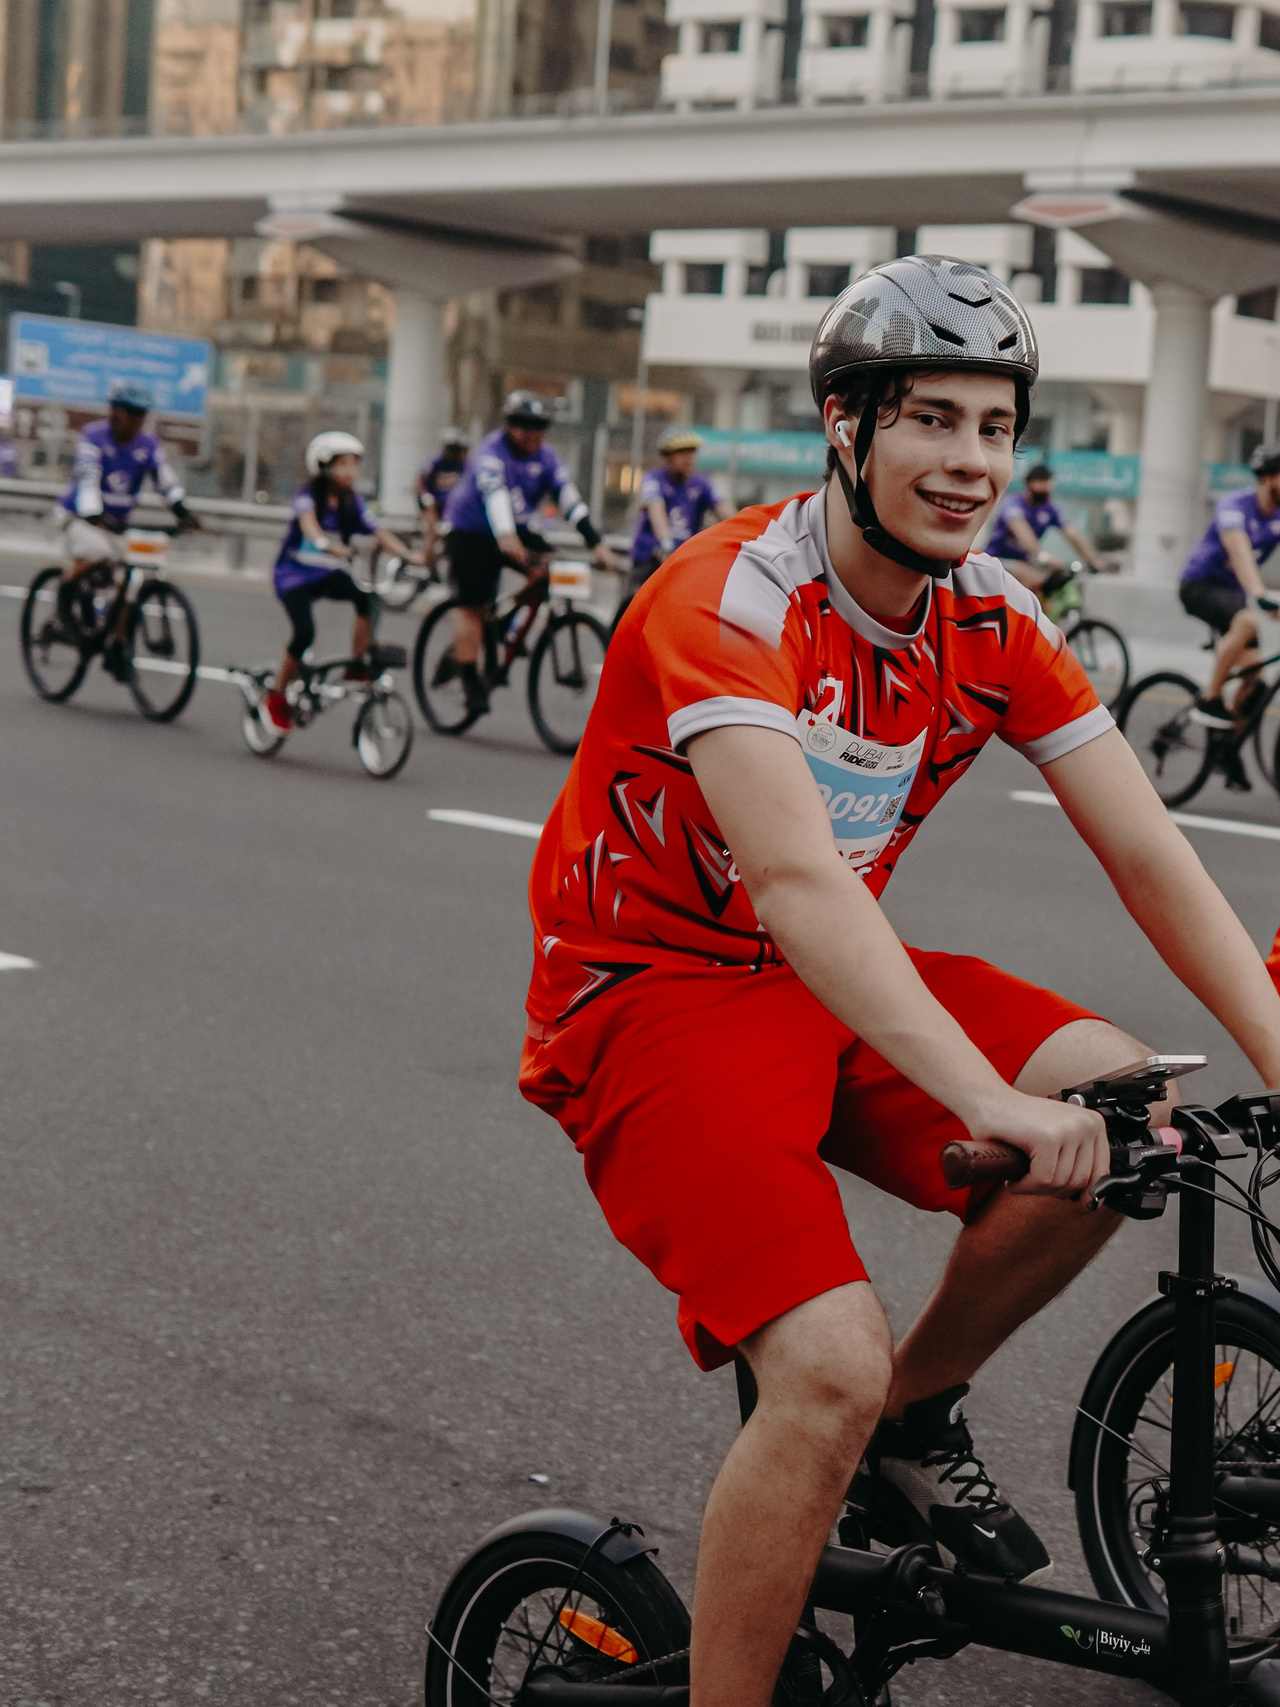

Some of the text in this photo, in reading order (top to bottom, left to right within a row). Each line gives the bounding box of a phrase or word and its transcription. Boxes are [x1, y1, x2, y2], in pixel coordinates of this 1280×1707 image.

[839, 751, 866, 767] RIDE
[845, 741, 887, 762] DUBAI
[1099, 1630, 1131, 1653] Biyiy
